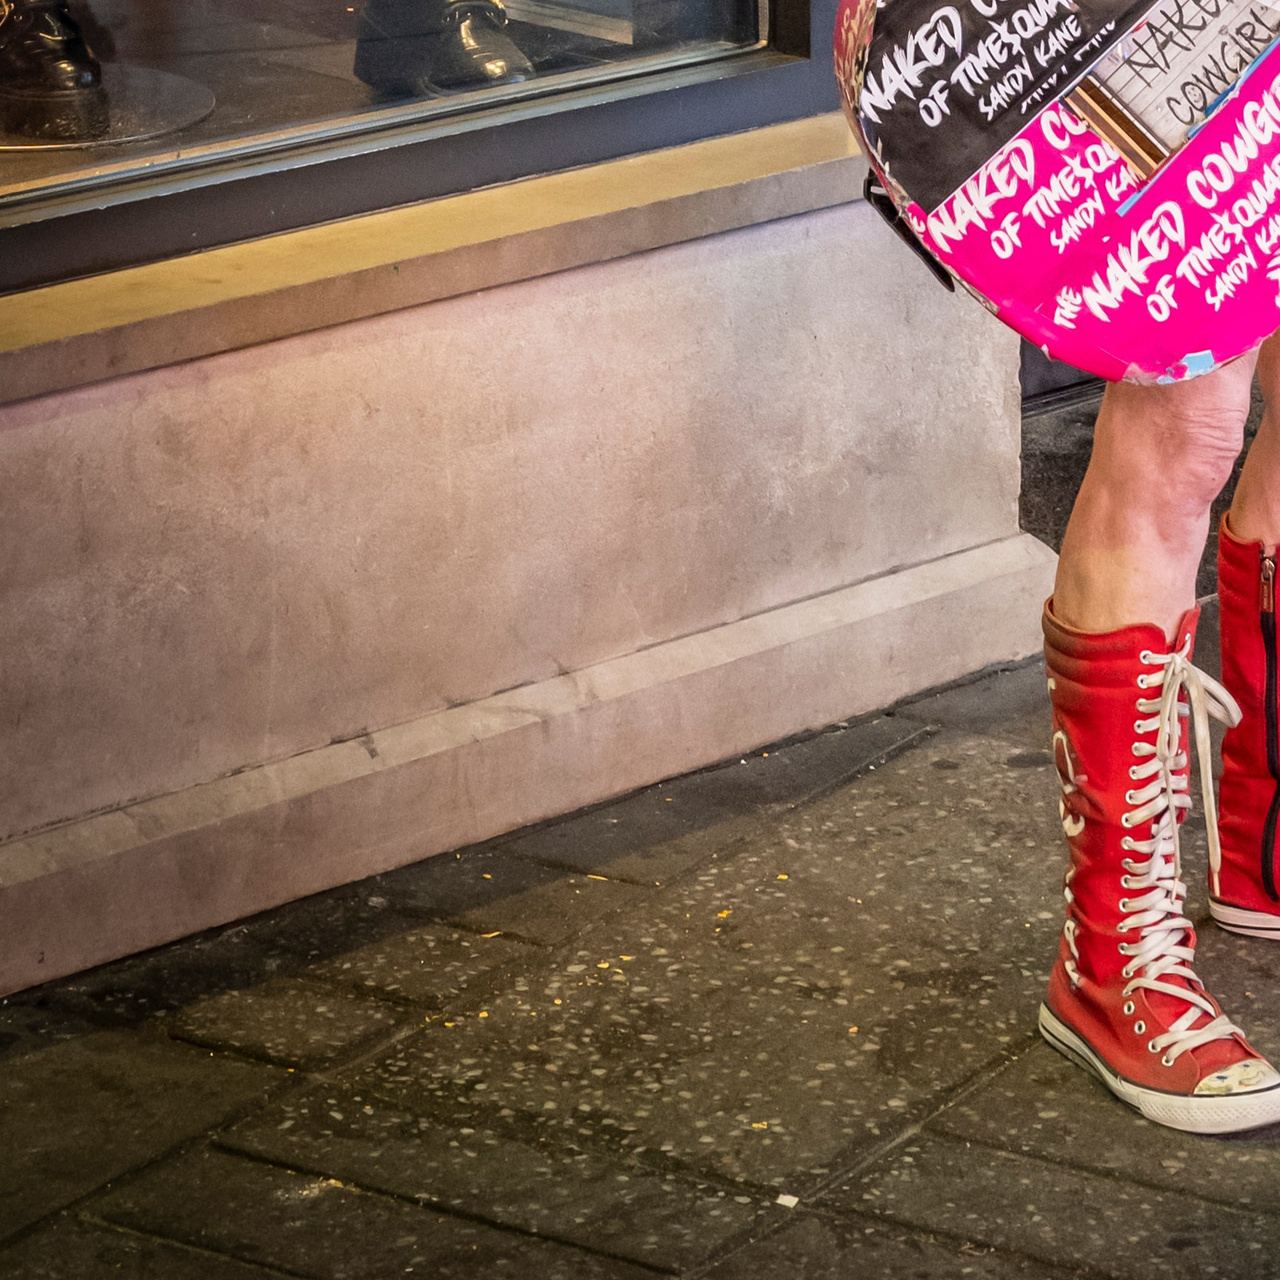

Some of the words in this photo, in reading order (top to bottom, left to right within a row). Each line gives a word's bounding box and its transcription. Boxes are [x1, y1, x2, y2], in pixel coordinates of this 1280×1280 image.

[860, 6, 962, 124] NAKED
[978, 55, 1035, 122] SANDY
[1033, 14, 1082, 68] KANE
[918, 79, 951, 127] OF
[926, 137, 1035, 254] NAKED
[1050, 189, 1106, 255] SANDY
[990, 211, 1022, 260] OF
[1053, 285, 1083, 329] THE
[1082, 200, 1186, 323] NAKED
[1146, 274, 1179, 323] OF
[1204, 244, 1259, 312] SANDY
